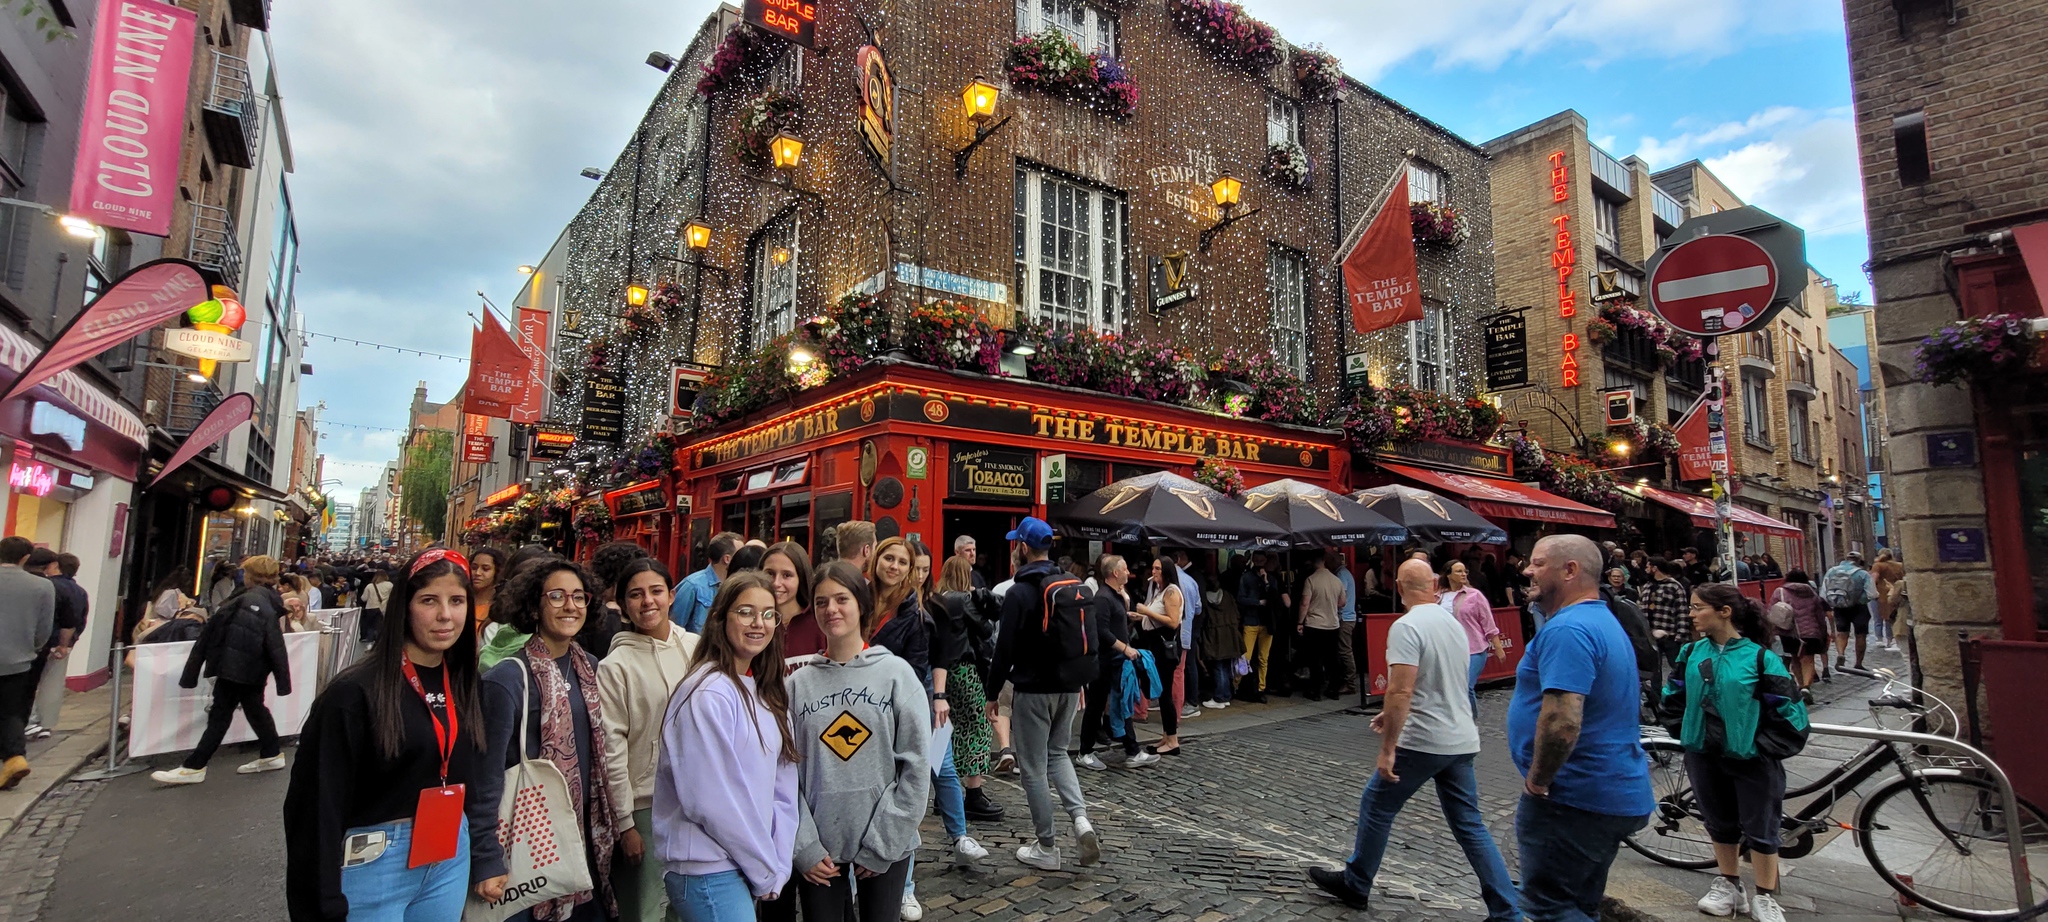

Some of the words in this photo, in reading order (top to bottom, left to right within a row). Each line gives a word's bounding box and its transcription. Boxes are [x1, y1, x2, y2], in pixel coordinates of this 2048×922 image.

[765, 9, 799, 34] BAR
[113, 2, 177, 84] NINE
[97, 89, 153, 197] CLOUD
[1548, 151, 1568, 201] THE
[92, 200, 126, 212] CLOUD
[128, 207, 153, 220] NINE
[1552, 214, 1576, 319] TEMPLE
[1371, 277, 1398, 290] THE
[1156, 290, 1188, 307] GUINNESS
[1353, 281, 1413, 305] TEMPLE
[82, 301, 149, 339] CLOUD
[151, 271, 197, 305] NINE
[1371, 297, 1404, 313] BAR
[1487, 322, 1525, 335] TEMPLE
[1495, 332, 1516, 341] BAR
[179, 332, 214, 344] CLOUD
[218, 337, 242, 350] NINE
[187, 345, 231, 358] GELATERIA
[1560, 332, 1579, 387] BAR
[480, 373, 524, 388] TEMPLE
[494, 370, 512, 379] THE
[490, 384, 512, 394] BAR
[587, 380, 624, 392] TEMPLE
[595, 391, 616, 399] BAR
[862, 402, 873, 418] 48
[928, 403, 944, 417] 48
[716, 440, 739, 463] THE
[742, 424, 797, 458] TEMPLE
[803, 409, 839, 439] BAR
[1033, 412, 1095, 442] THE
[1104, 422, 1206, 455] TEMPLE
[1216, 438, 1261, 462] BAR
[953, 449, 989, 463] Importers
[962, 464, 1025, 490] TOBACCO
[975, 485, 999, 494] Always
[1010, 487, 1028, 495] Stock
[799, 686, 894, 721] AUSTRALIA
